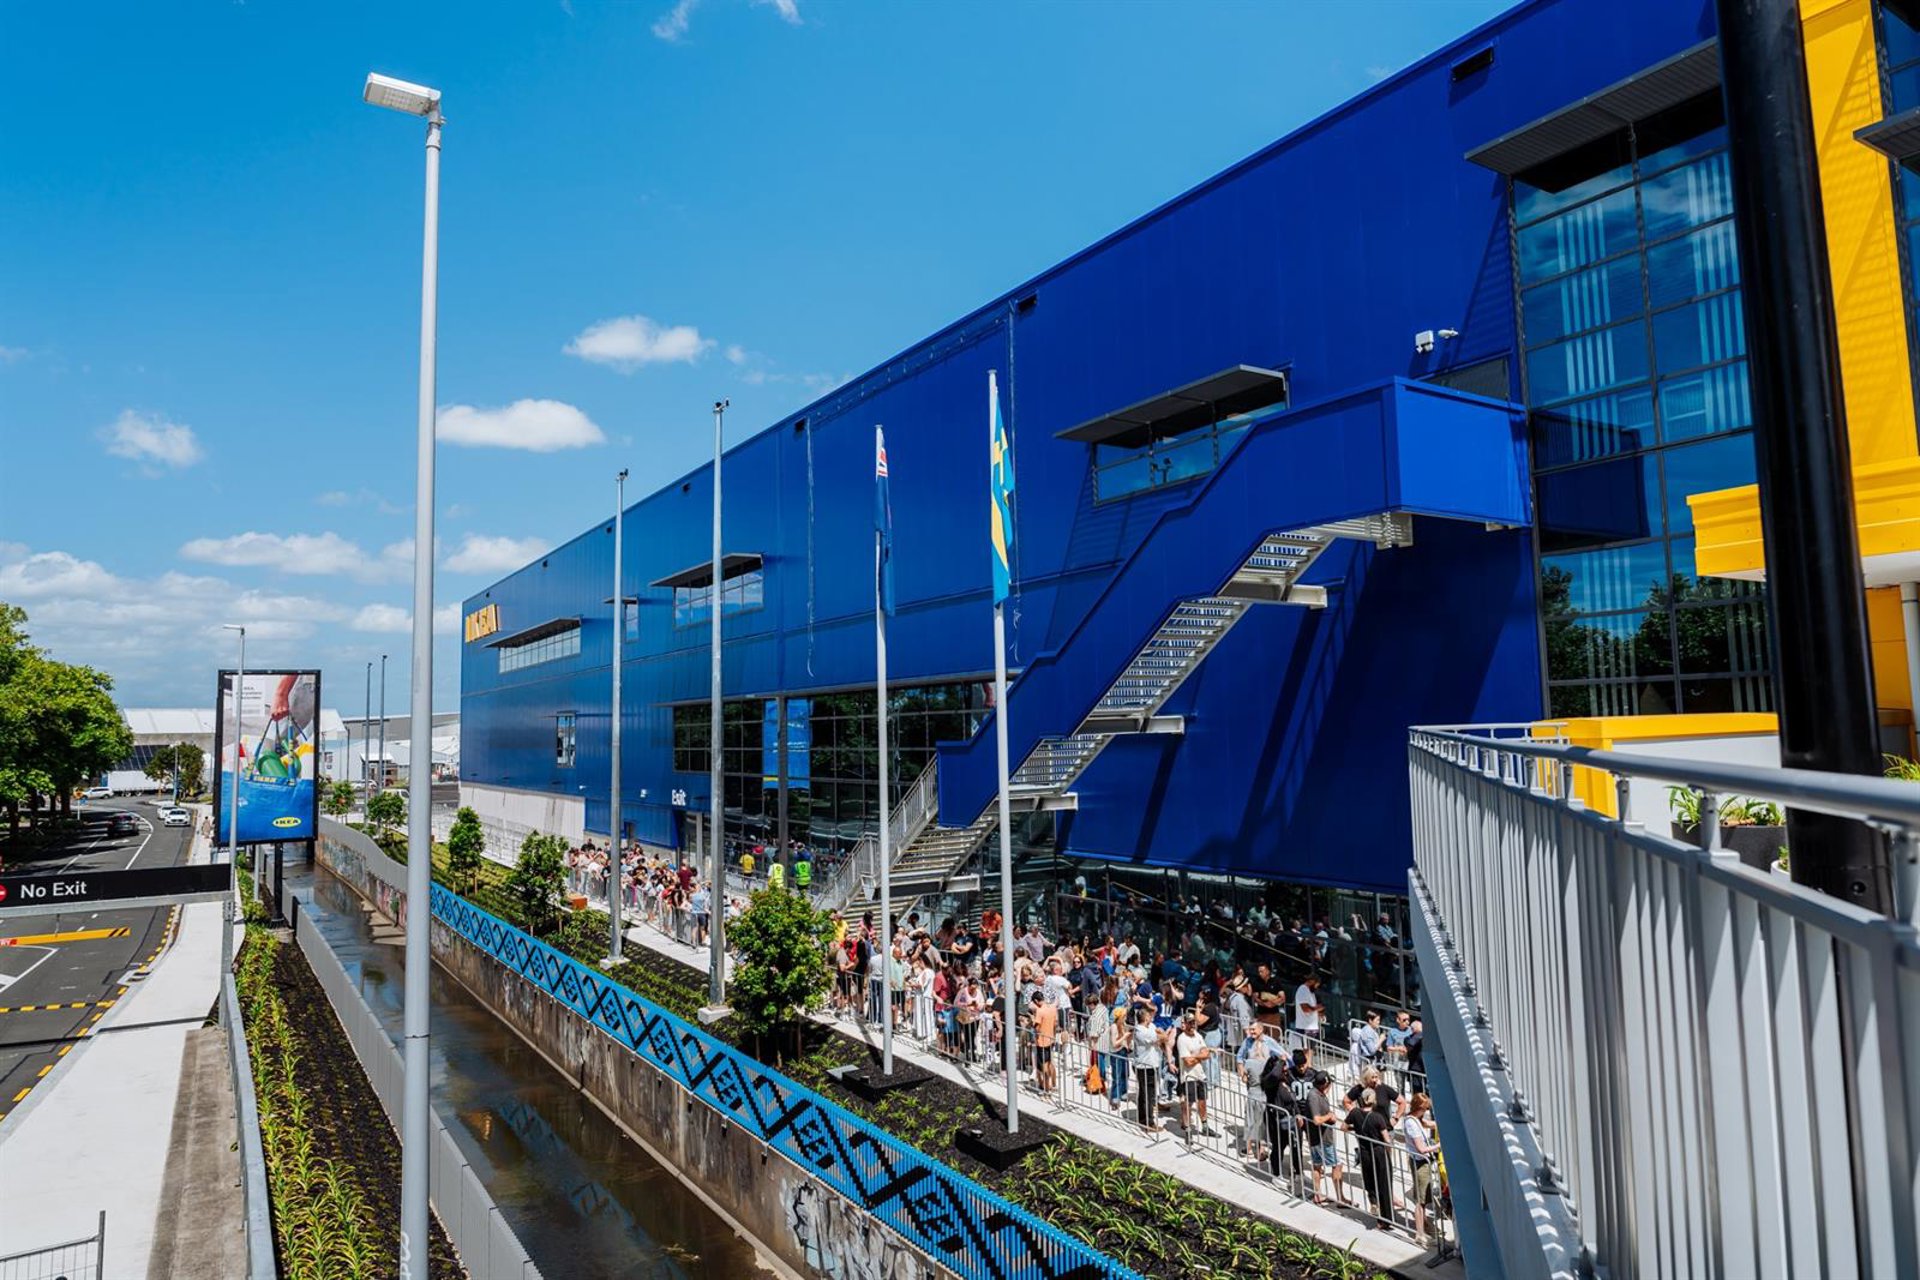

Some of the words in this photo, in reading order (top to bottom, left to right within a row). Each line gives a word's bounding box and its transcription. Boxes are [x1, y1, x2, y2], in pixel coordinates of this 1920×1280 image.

[672, 788, 687, 807] Exit
[20, 884, 46, 899] No
[53, 881, 87, 896] Exit
